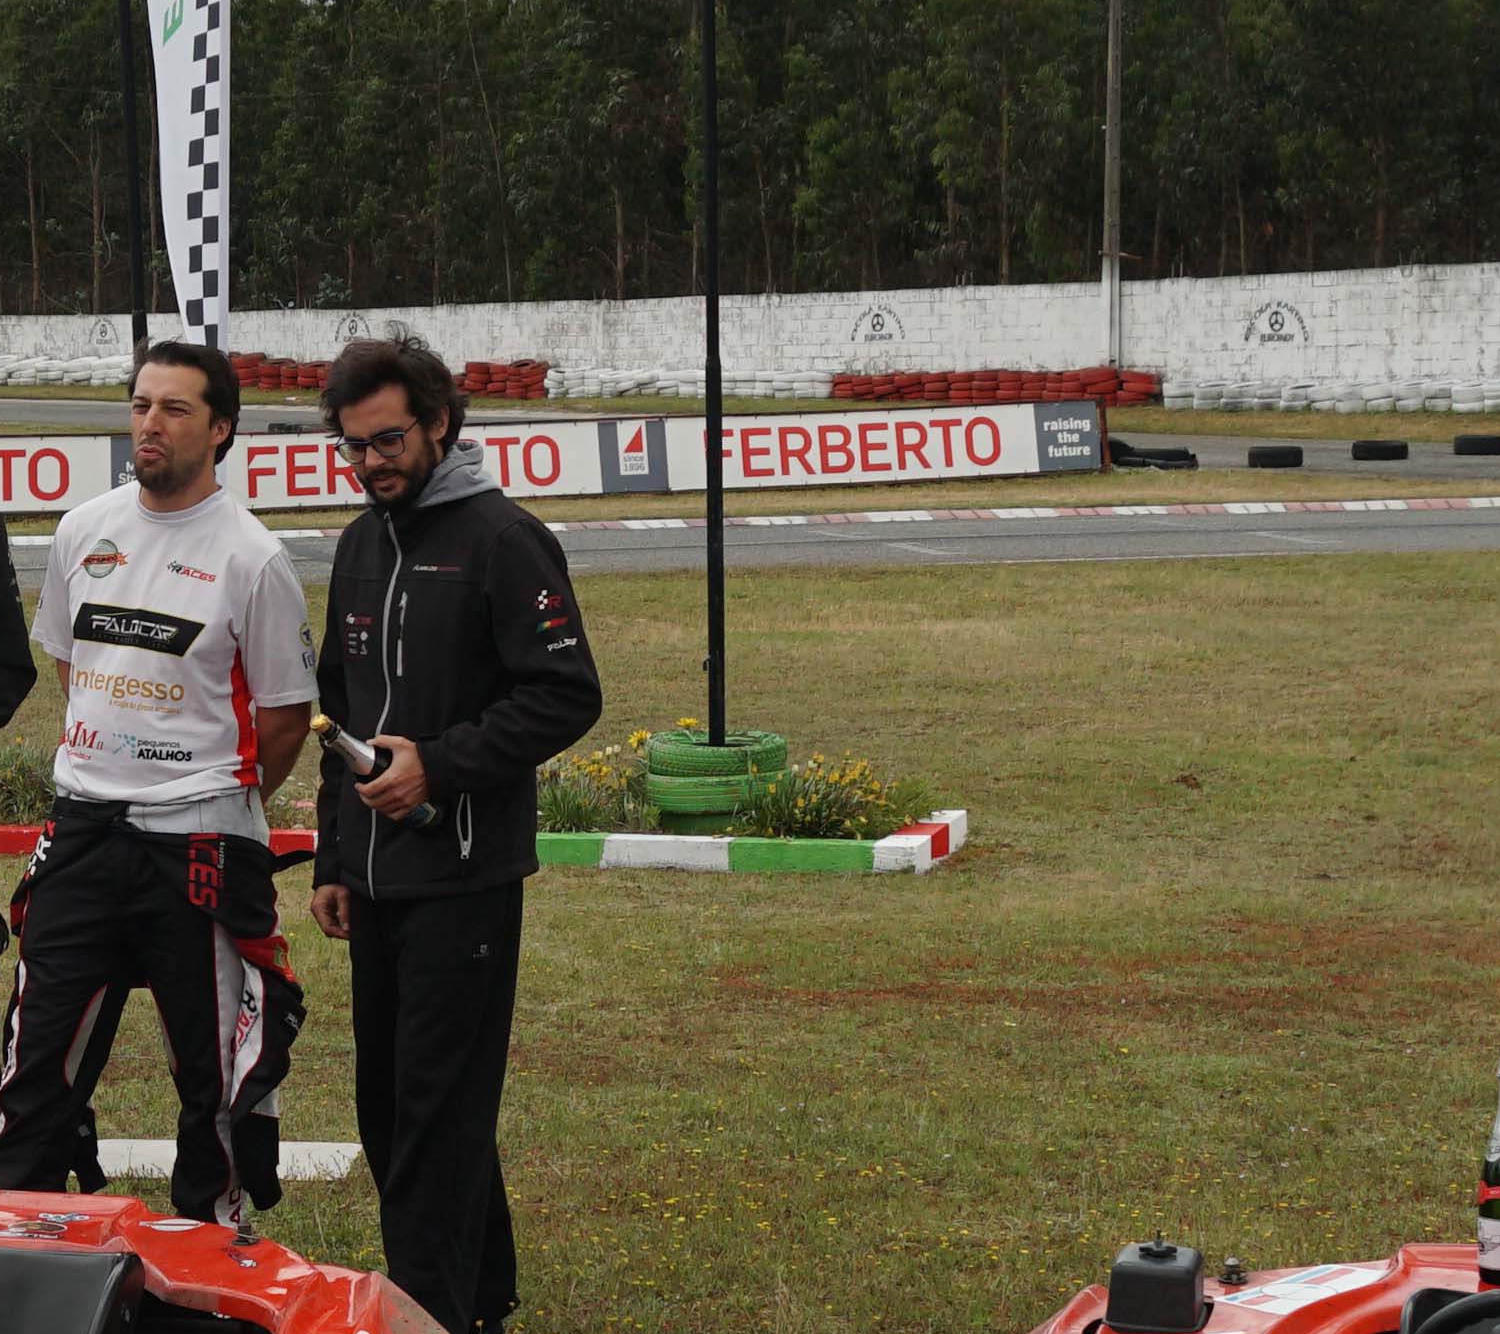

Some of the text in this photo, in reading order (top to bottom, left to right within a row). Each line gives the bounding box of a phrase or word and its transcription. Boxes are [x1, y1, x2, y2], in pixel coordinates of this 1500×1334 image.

[1043, 417, 1092, 433] raising
[1057, 431, 1081, 445] the
[1047, 443, 1092, 458] future
[136, 739, 181, 749] pequenos
[136, 747, 193, 762] ATALHOS
